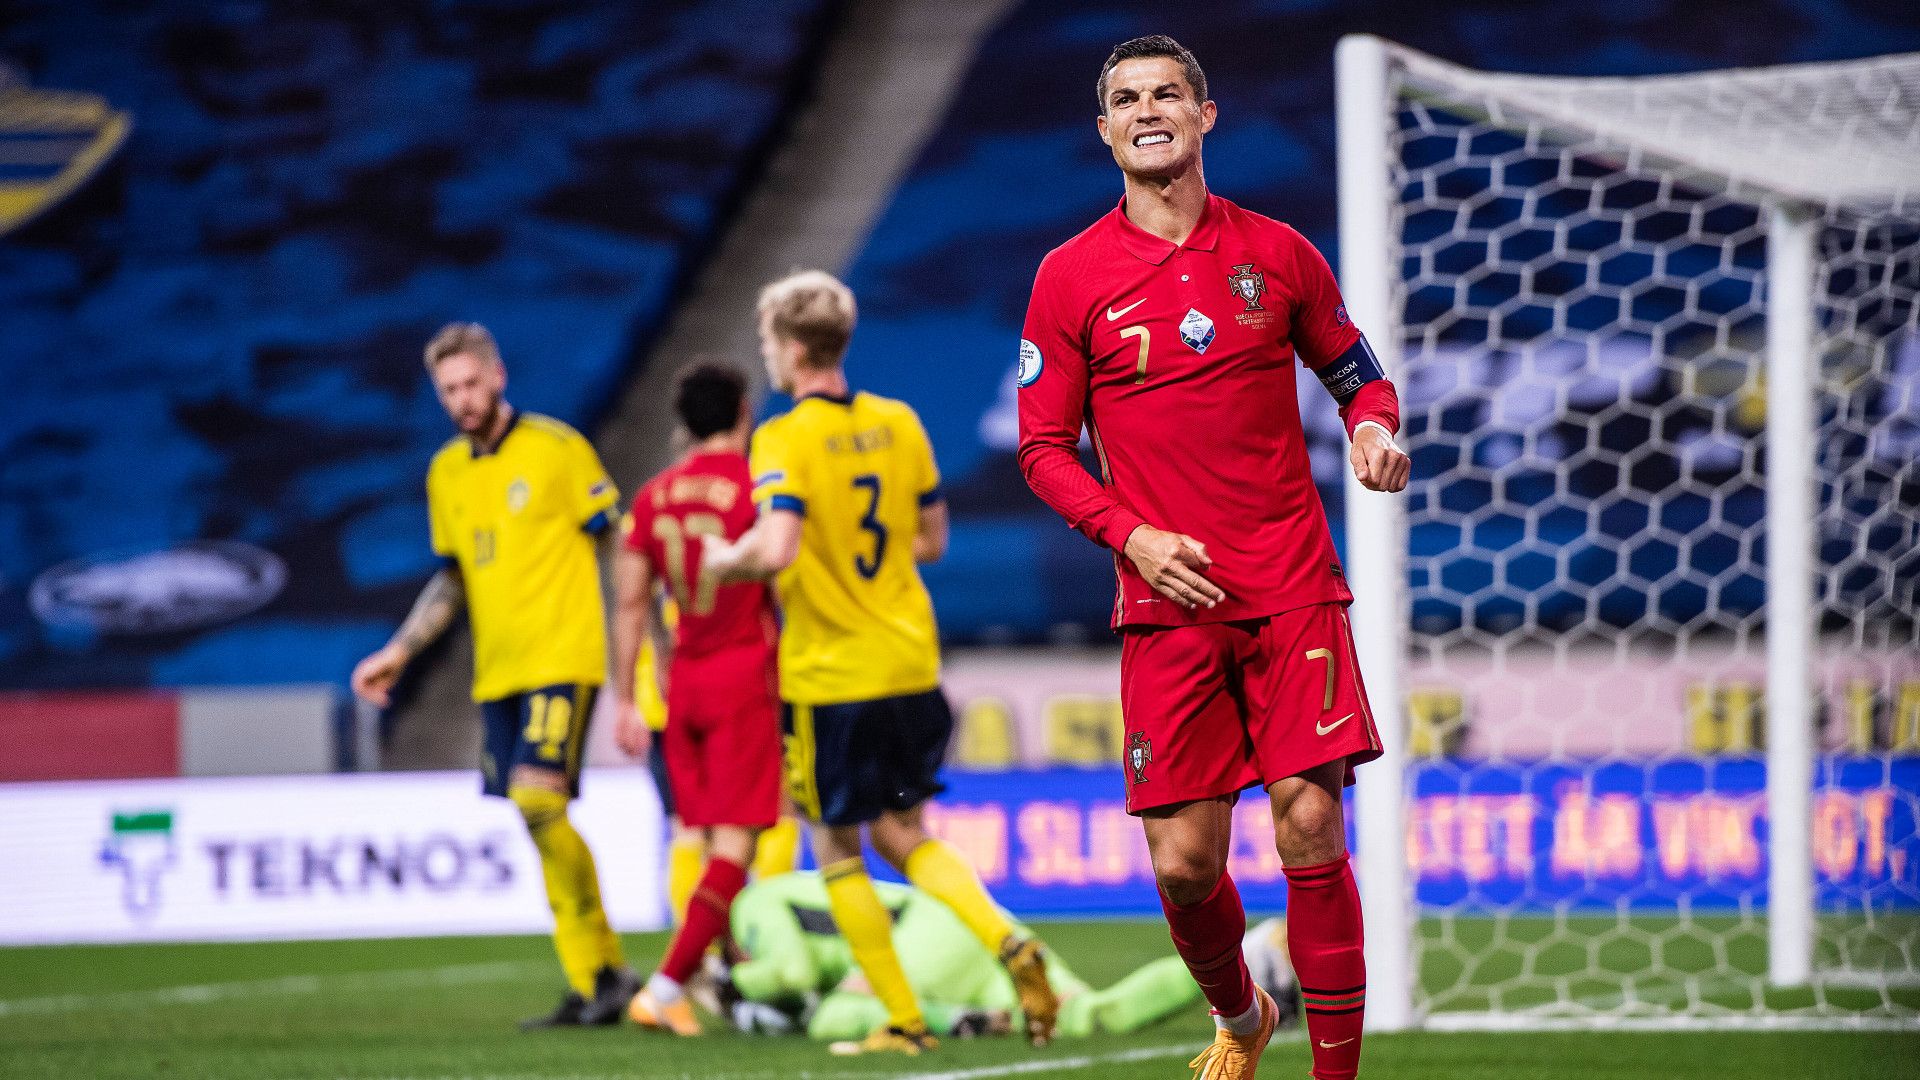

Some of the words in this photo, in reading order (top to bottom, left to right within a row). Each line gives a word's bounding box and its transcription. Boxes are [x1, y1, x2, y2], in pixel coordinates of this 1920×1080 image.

[1120, 325, 1151, 385] 7
[851, 474, 890, 582] 3
[652, 511, 726, 617] 17
[1305, 647, 1335, 710] 7
[205, 833, 515, 896] TEKNOS
